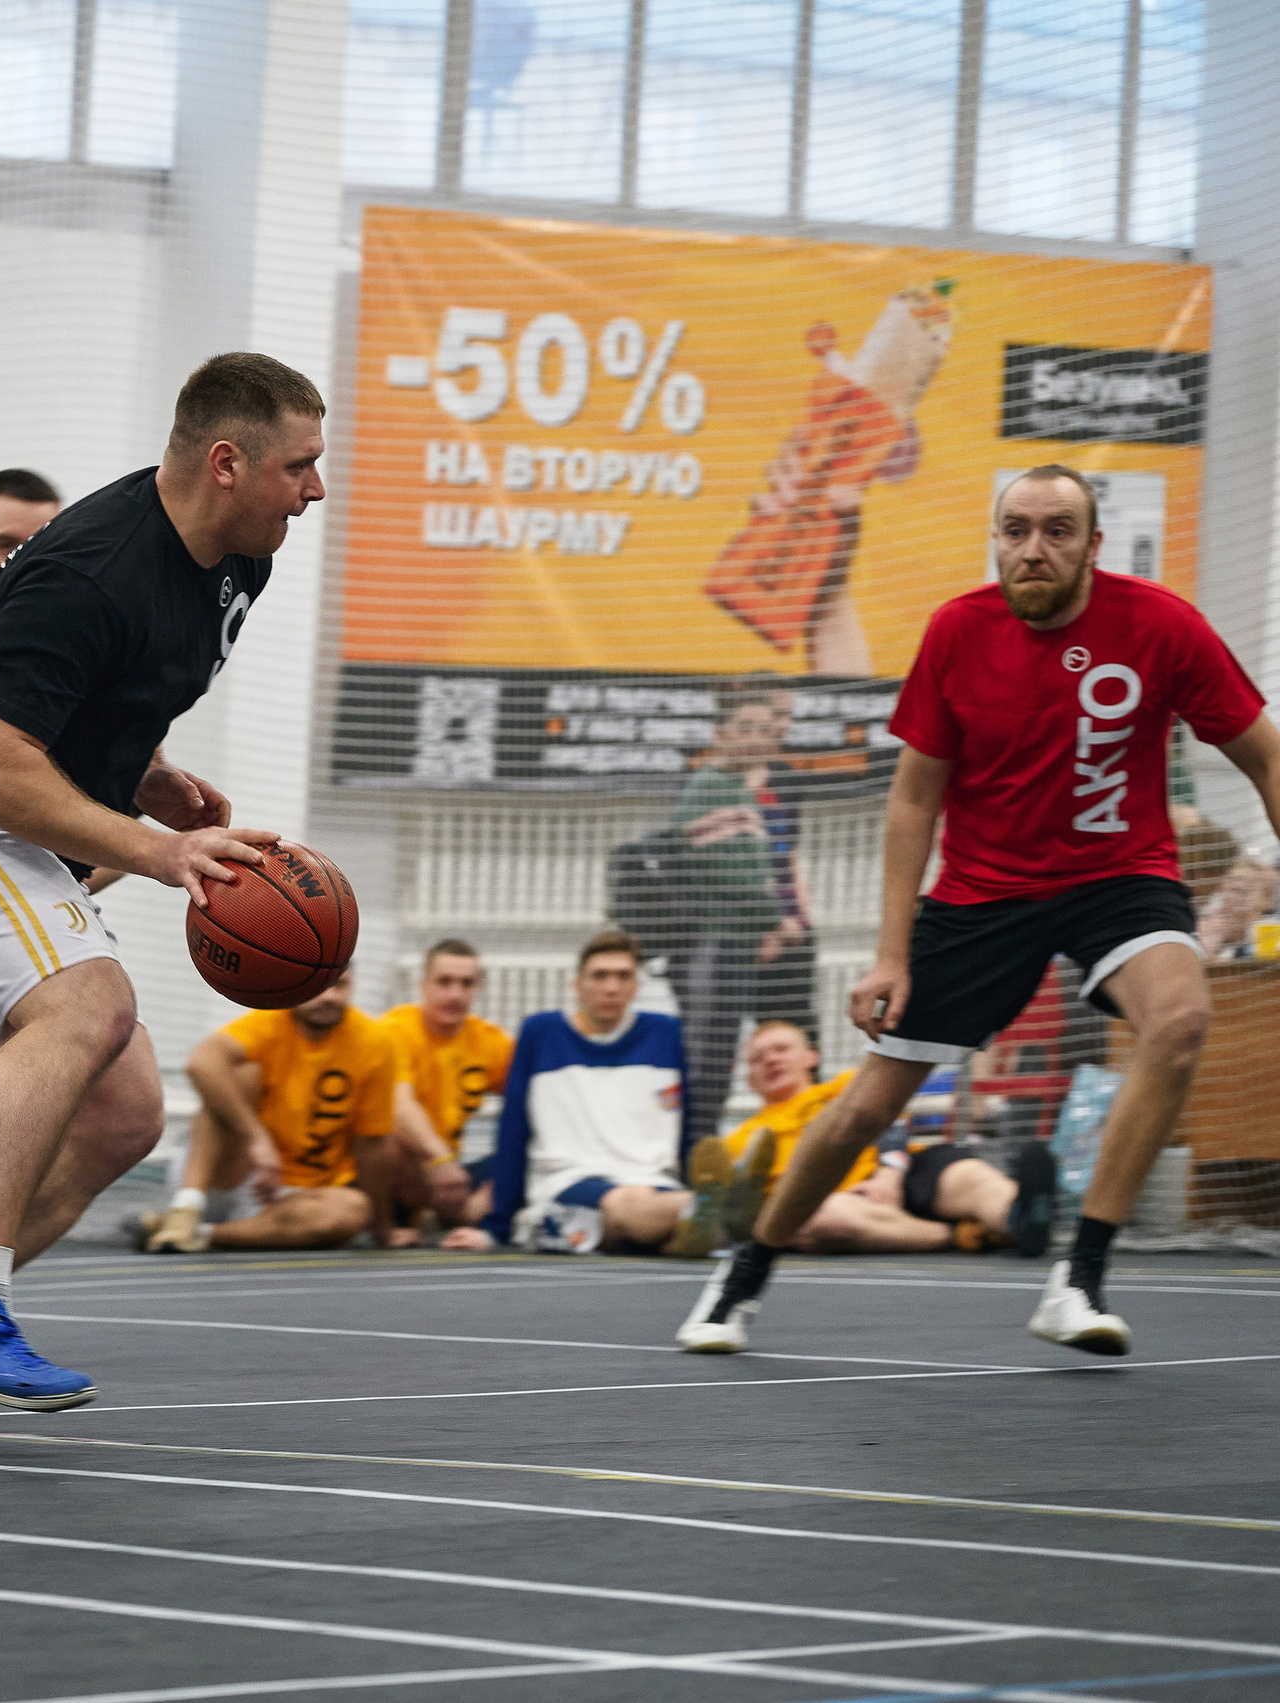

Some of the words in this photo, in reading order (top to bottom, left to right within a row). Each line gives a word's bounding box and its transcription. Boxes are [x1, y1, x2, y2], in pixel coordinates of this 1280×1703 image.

[386, 307, 705, 436] -50%
[426, 440, 490, 486] НА
[504, 445, 703, 500] ВТОРУЮ
[424, 502, 632, 556] ШАУРМУ
[198, 934, 241, 974] FIBA
